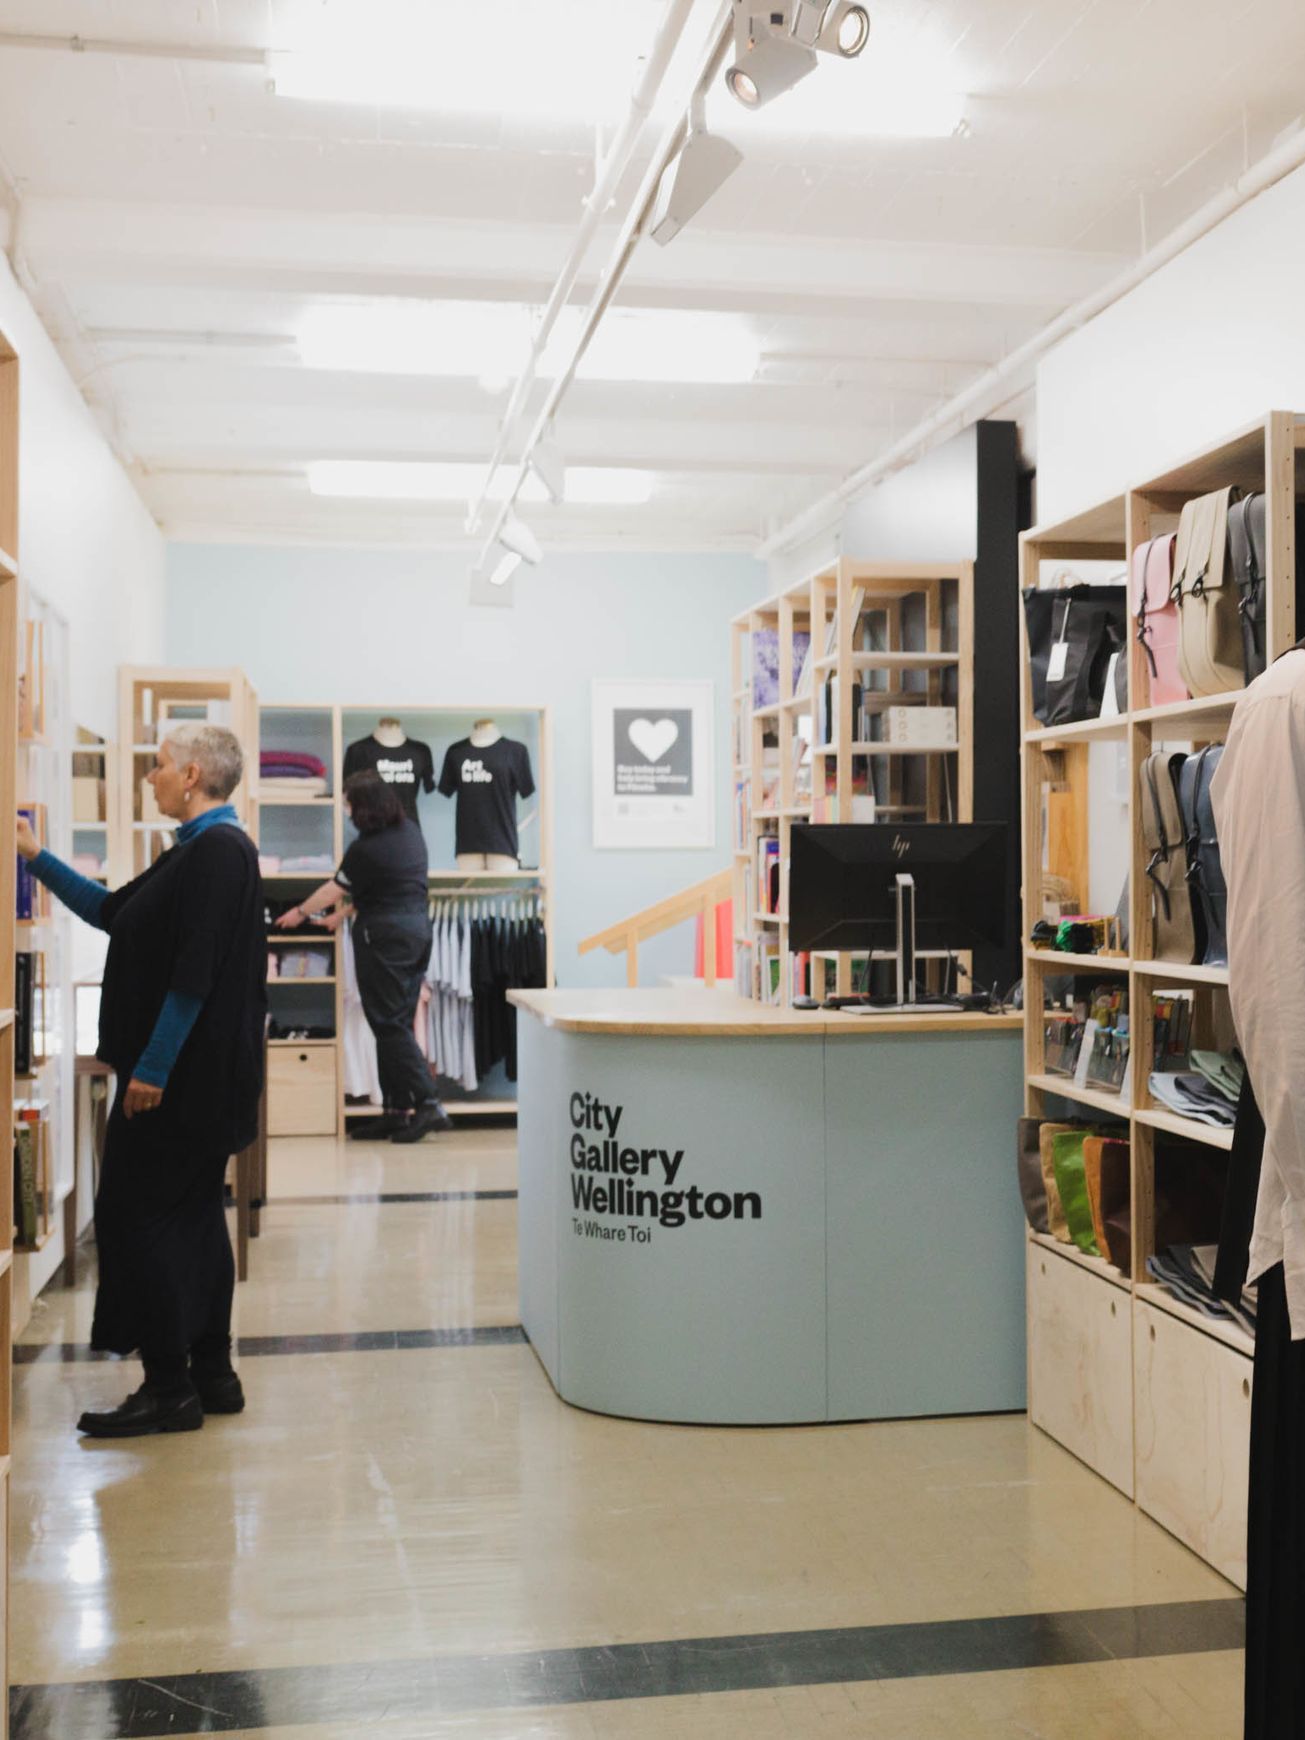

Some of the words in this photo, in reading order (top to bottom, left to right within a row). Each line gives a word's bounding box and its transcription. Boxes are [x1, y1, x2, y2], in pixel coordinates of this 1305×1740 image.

[892, 834, 910, 858] hp
[570, 1091, 623, 1138] City
[570, 1133, 685, 1185] Gallery
[571, 1173, 762, 1227] Wellington
[572, 1217, 583, 1236] Te
[584, 1220, 626, 1242] Whare
[628, 1225, 651, 1243] Toi
